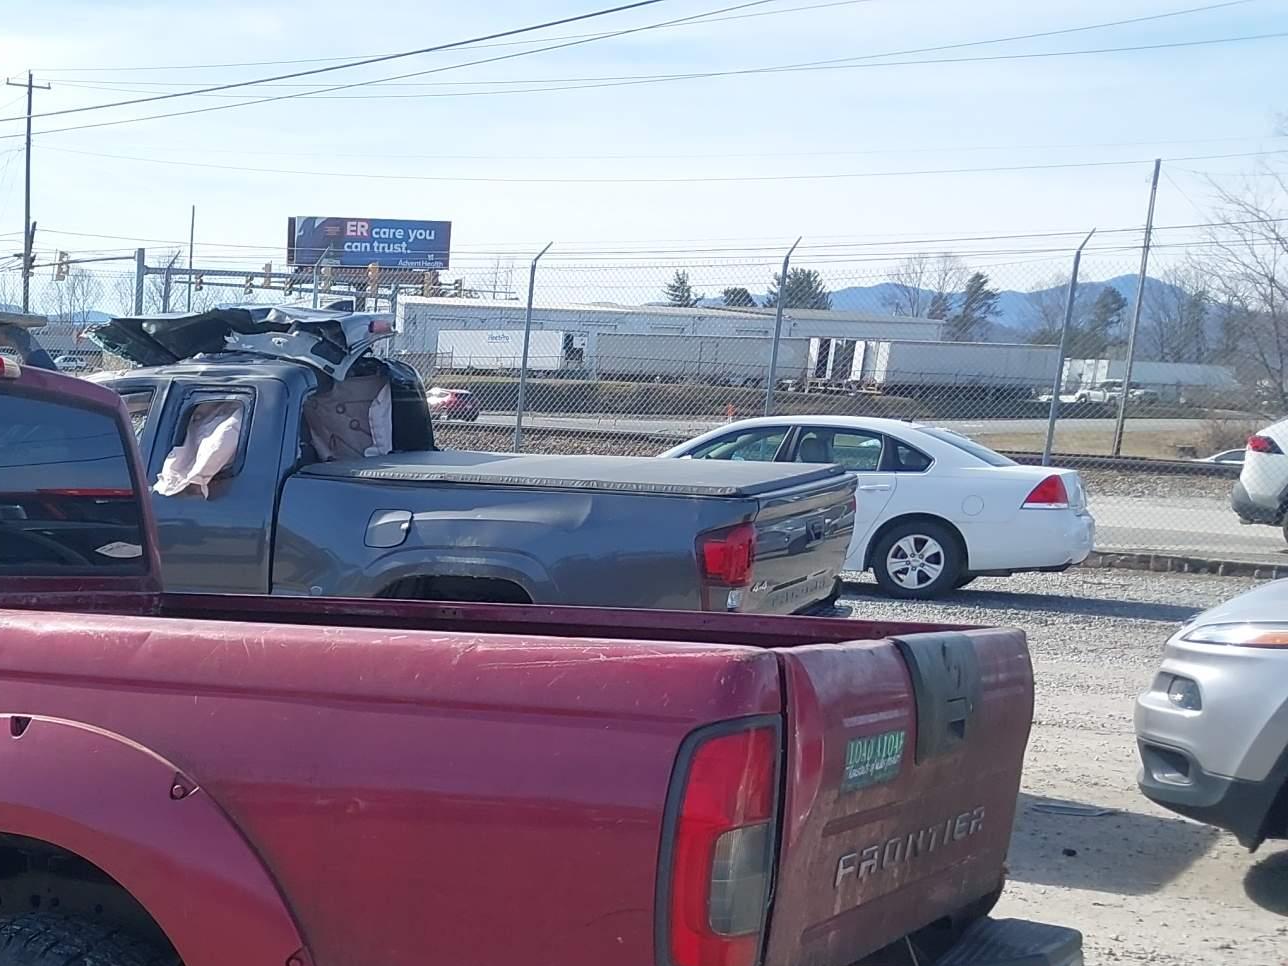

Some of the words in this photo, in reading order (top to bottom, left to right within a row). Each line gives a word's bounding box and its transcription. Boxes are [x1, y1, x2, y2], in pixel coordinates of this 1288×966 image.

[346, 221, 369, 236] ER
[372, 228, 404, 238] care
[408, 229, 435, 242] you
[344, 241, 370, 252] can
[373, 240, 411, 253] trust.
[833, 806, 985, 888] FRONTIER
